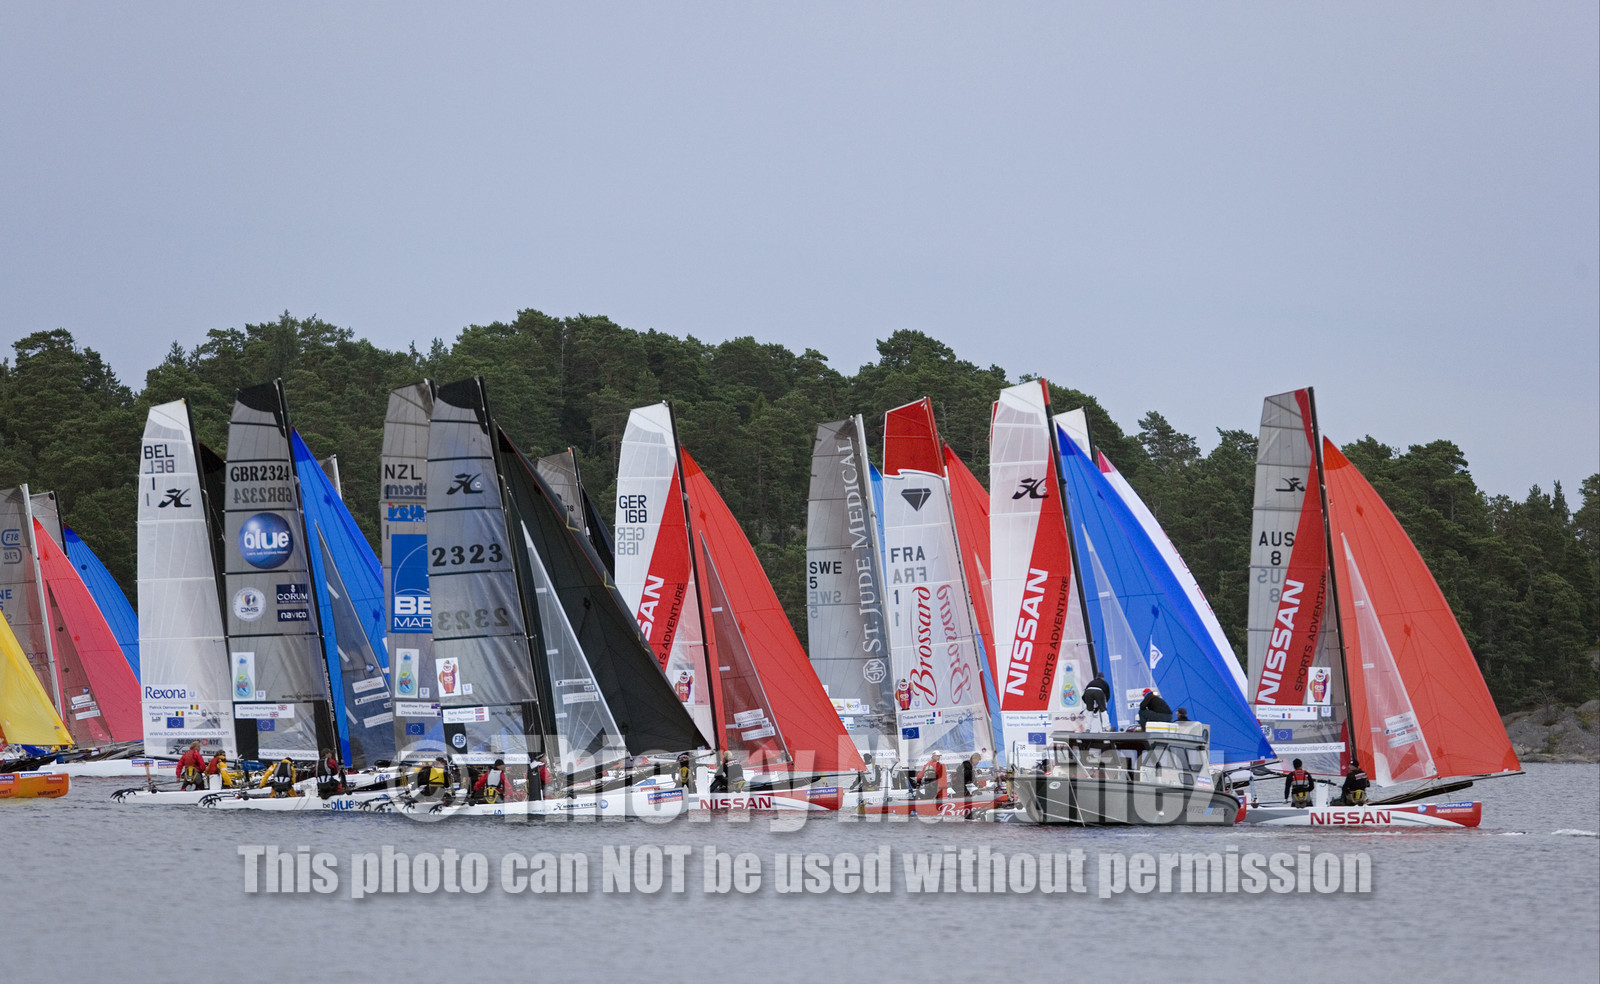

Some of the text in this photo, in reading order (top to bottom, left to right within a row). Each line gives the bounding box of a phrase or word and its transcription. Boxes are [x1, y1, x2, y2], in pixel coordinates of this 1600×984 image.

[144, 444, 175, 459] BEL
[230, 465, 290, 482] GBR2324
[384, 464, 422, 480] NZL
[618, 495, 647, 509] GER
[837, 436, 869, 551] MEDICAL
[625, 509, 647, 523] 168
[243, 529, 289, 549] blue
[1259, 531, 1295, 547] AUS
[431, 544, 503, 567] 2323
[890, 545, 926, 563] FRA
[1270, 551, 1281, 565] 8
[809, 561, 842, 574] SWE
[809, 576, 818, 589] 5
[855, 556, 882, 617] JUDE
[636, 574, 665, 642] SAN
[663, 583, 685, 651] ADVENTURE
[1006, 568, 1049, 696] NISSAN
[1038, 576, 1069, 701] SPORTS ADVENTURE
[1294, 570, 1326, 692] SPORTS ADVENTURE
[910, 586, 938, 707] Brossard
[1257, 579, 1304, 705] NISSAN
[145, 686, 186, 699] Rexona
[331, 799, 355, 810] blue
[700, 797, 772, 809] NISSAN
[1310, 811, 1391, 825] NISSAN
